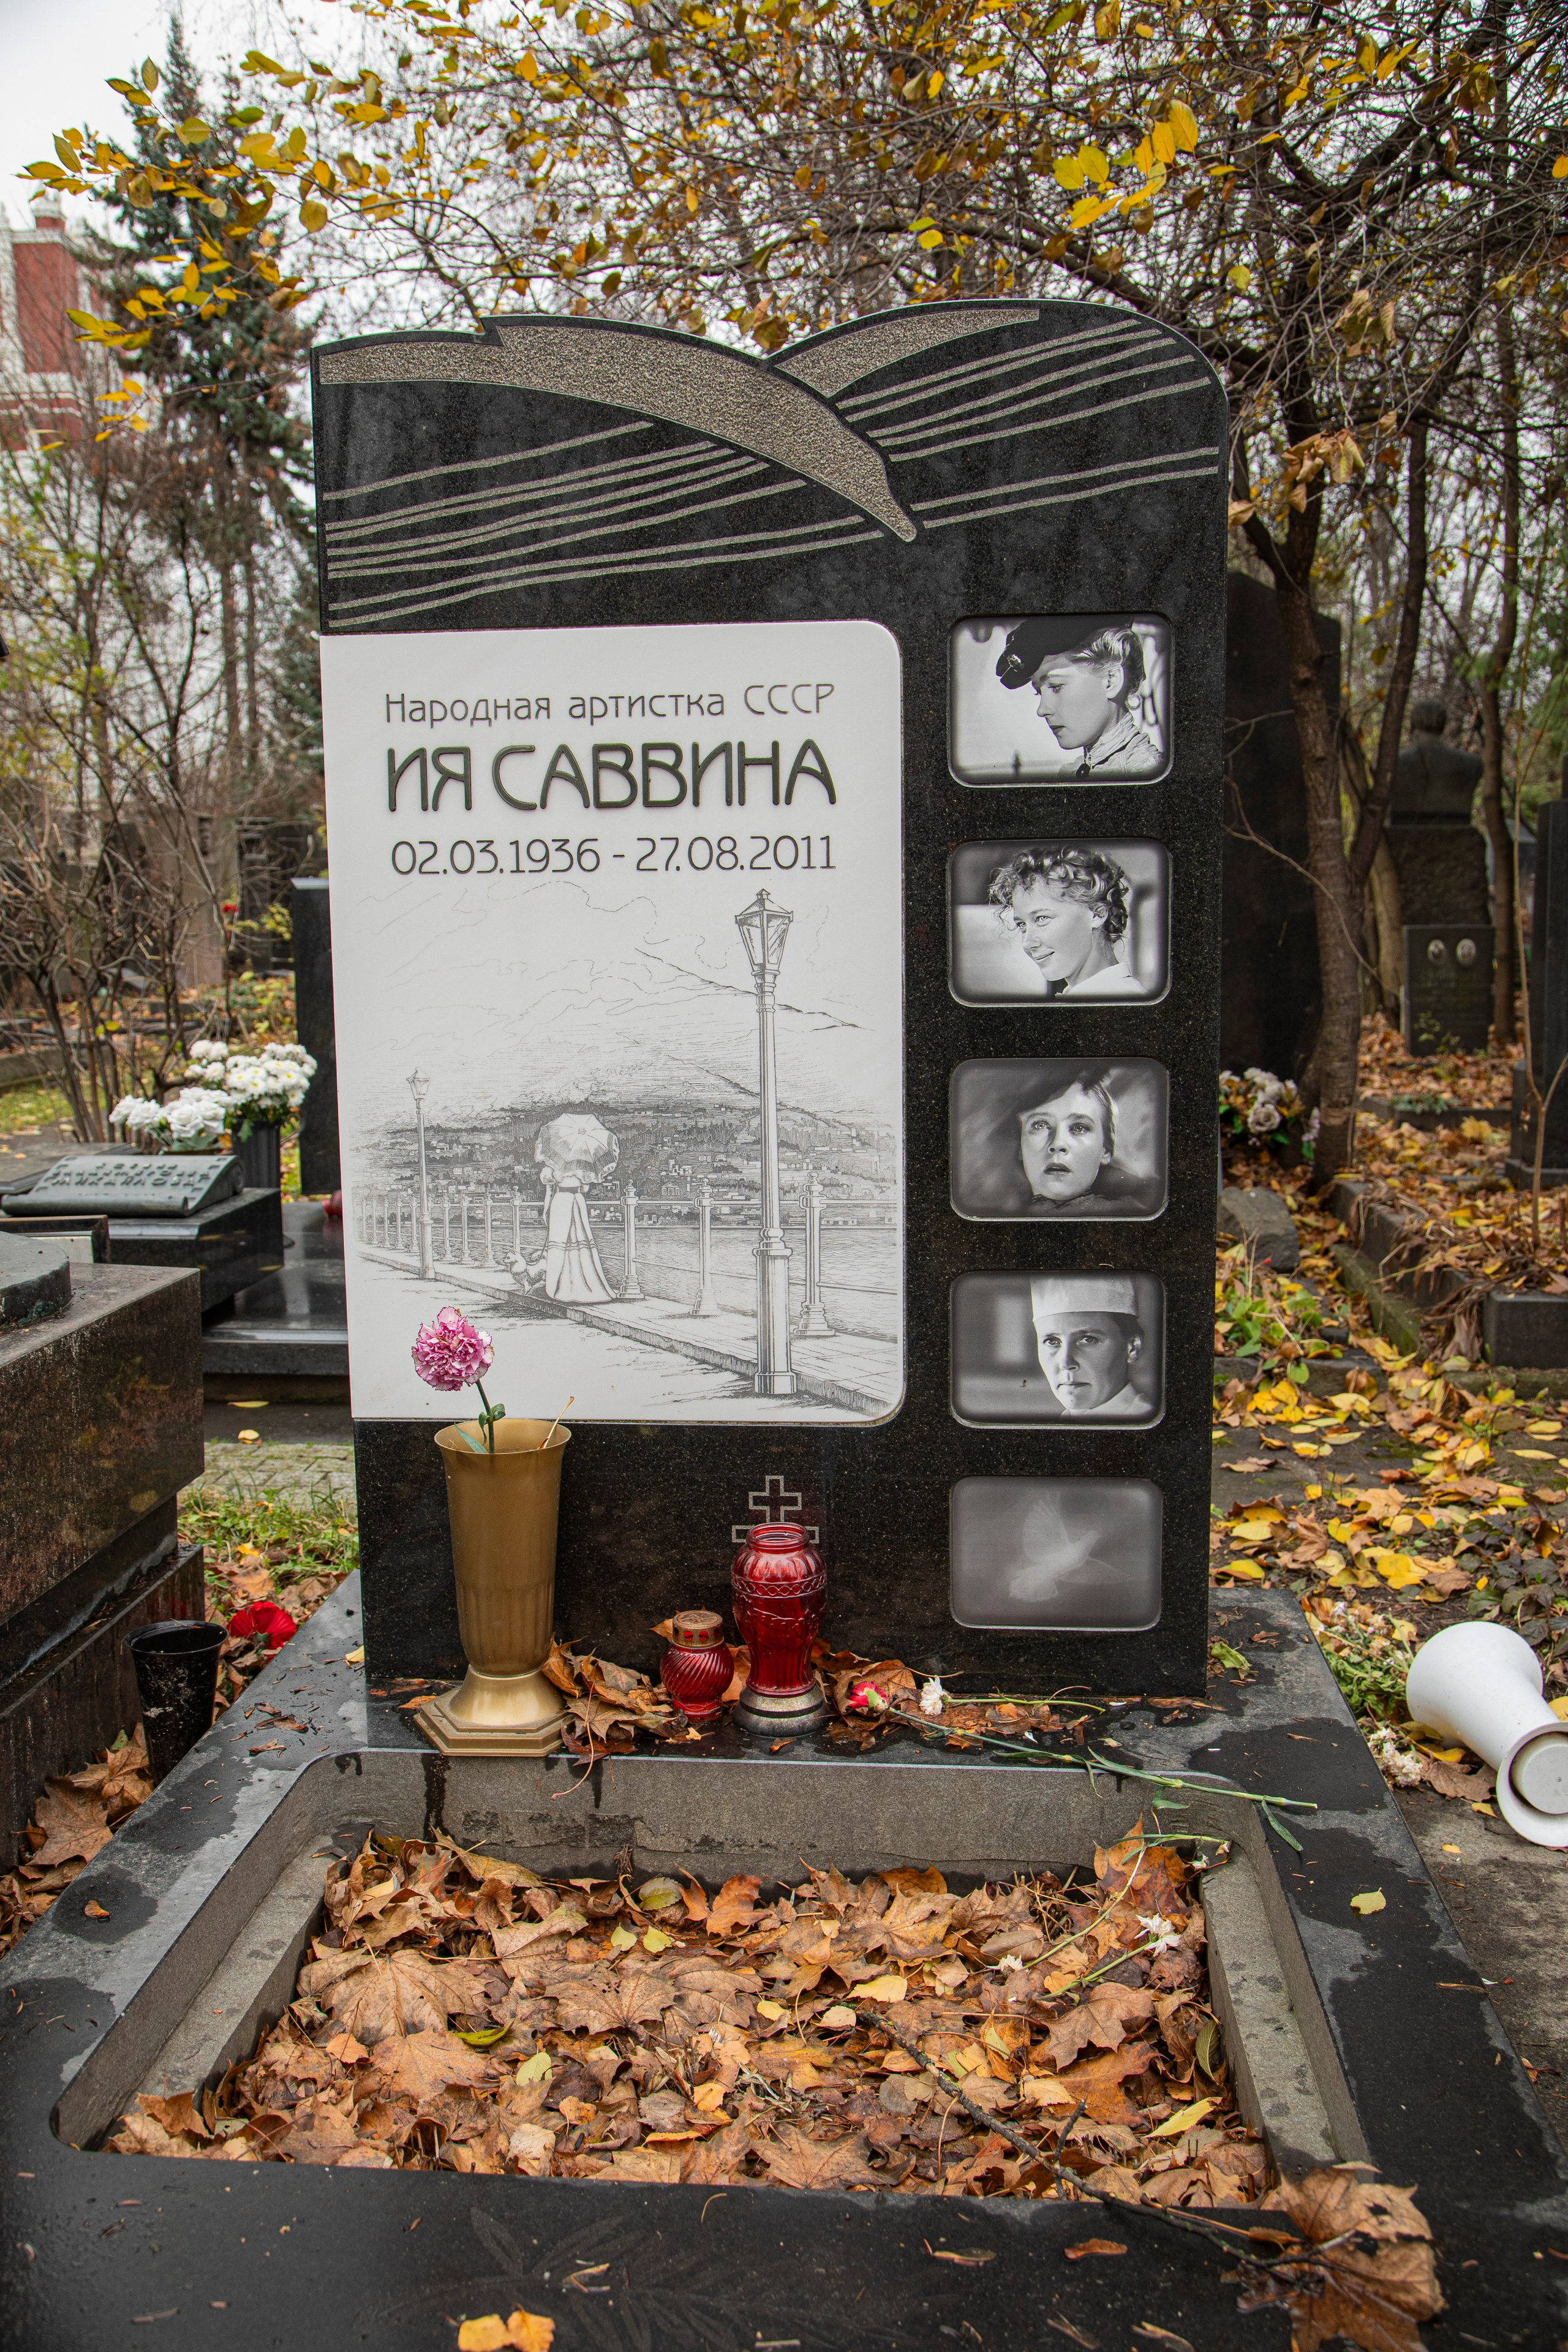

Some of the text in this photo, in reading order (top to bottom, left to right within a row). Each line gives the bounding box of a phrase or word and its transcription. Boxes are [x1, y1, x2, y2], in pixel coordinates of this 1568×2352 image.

[385, 683, 835, 729] Народная артистка СССР
[387, 738, 837, 813] ИЯ САВВИНА
[391, 838, 600, 875] 02.03.1936
[635, 834, 836, 872] 27.08.2011
